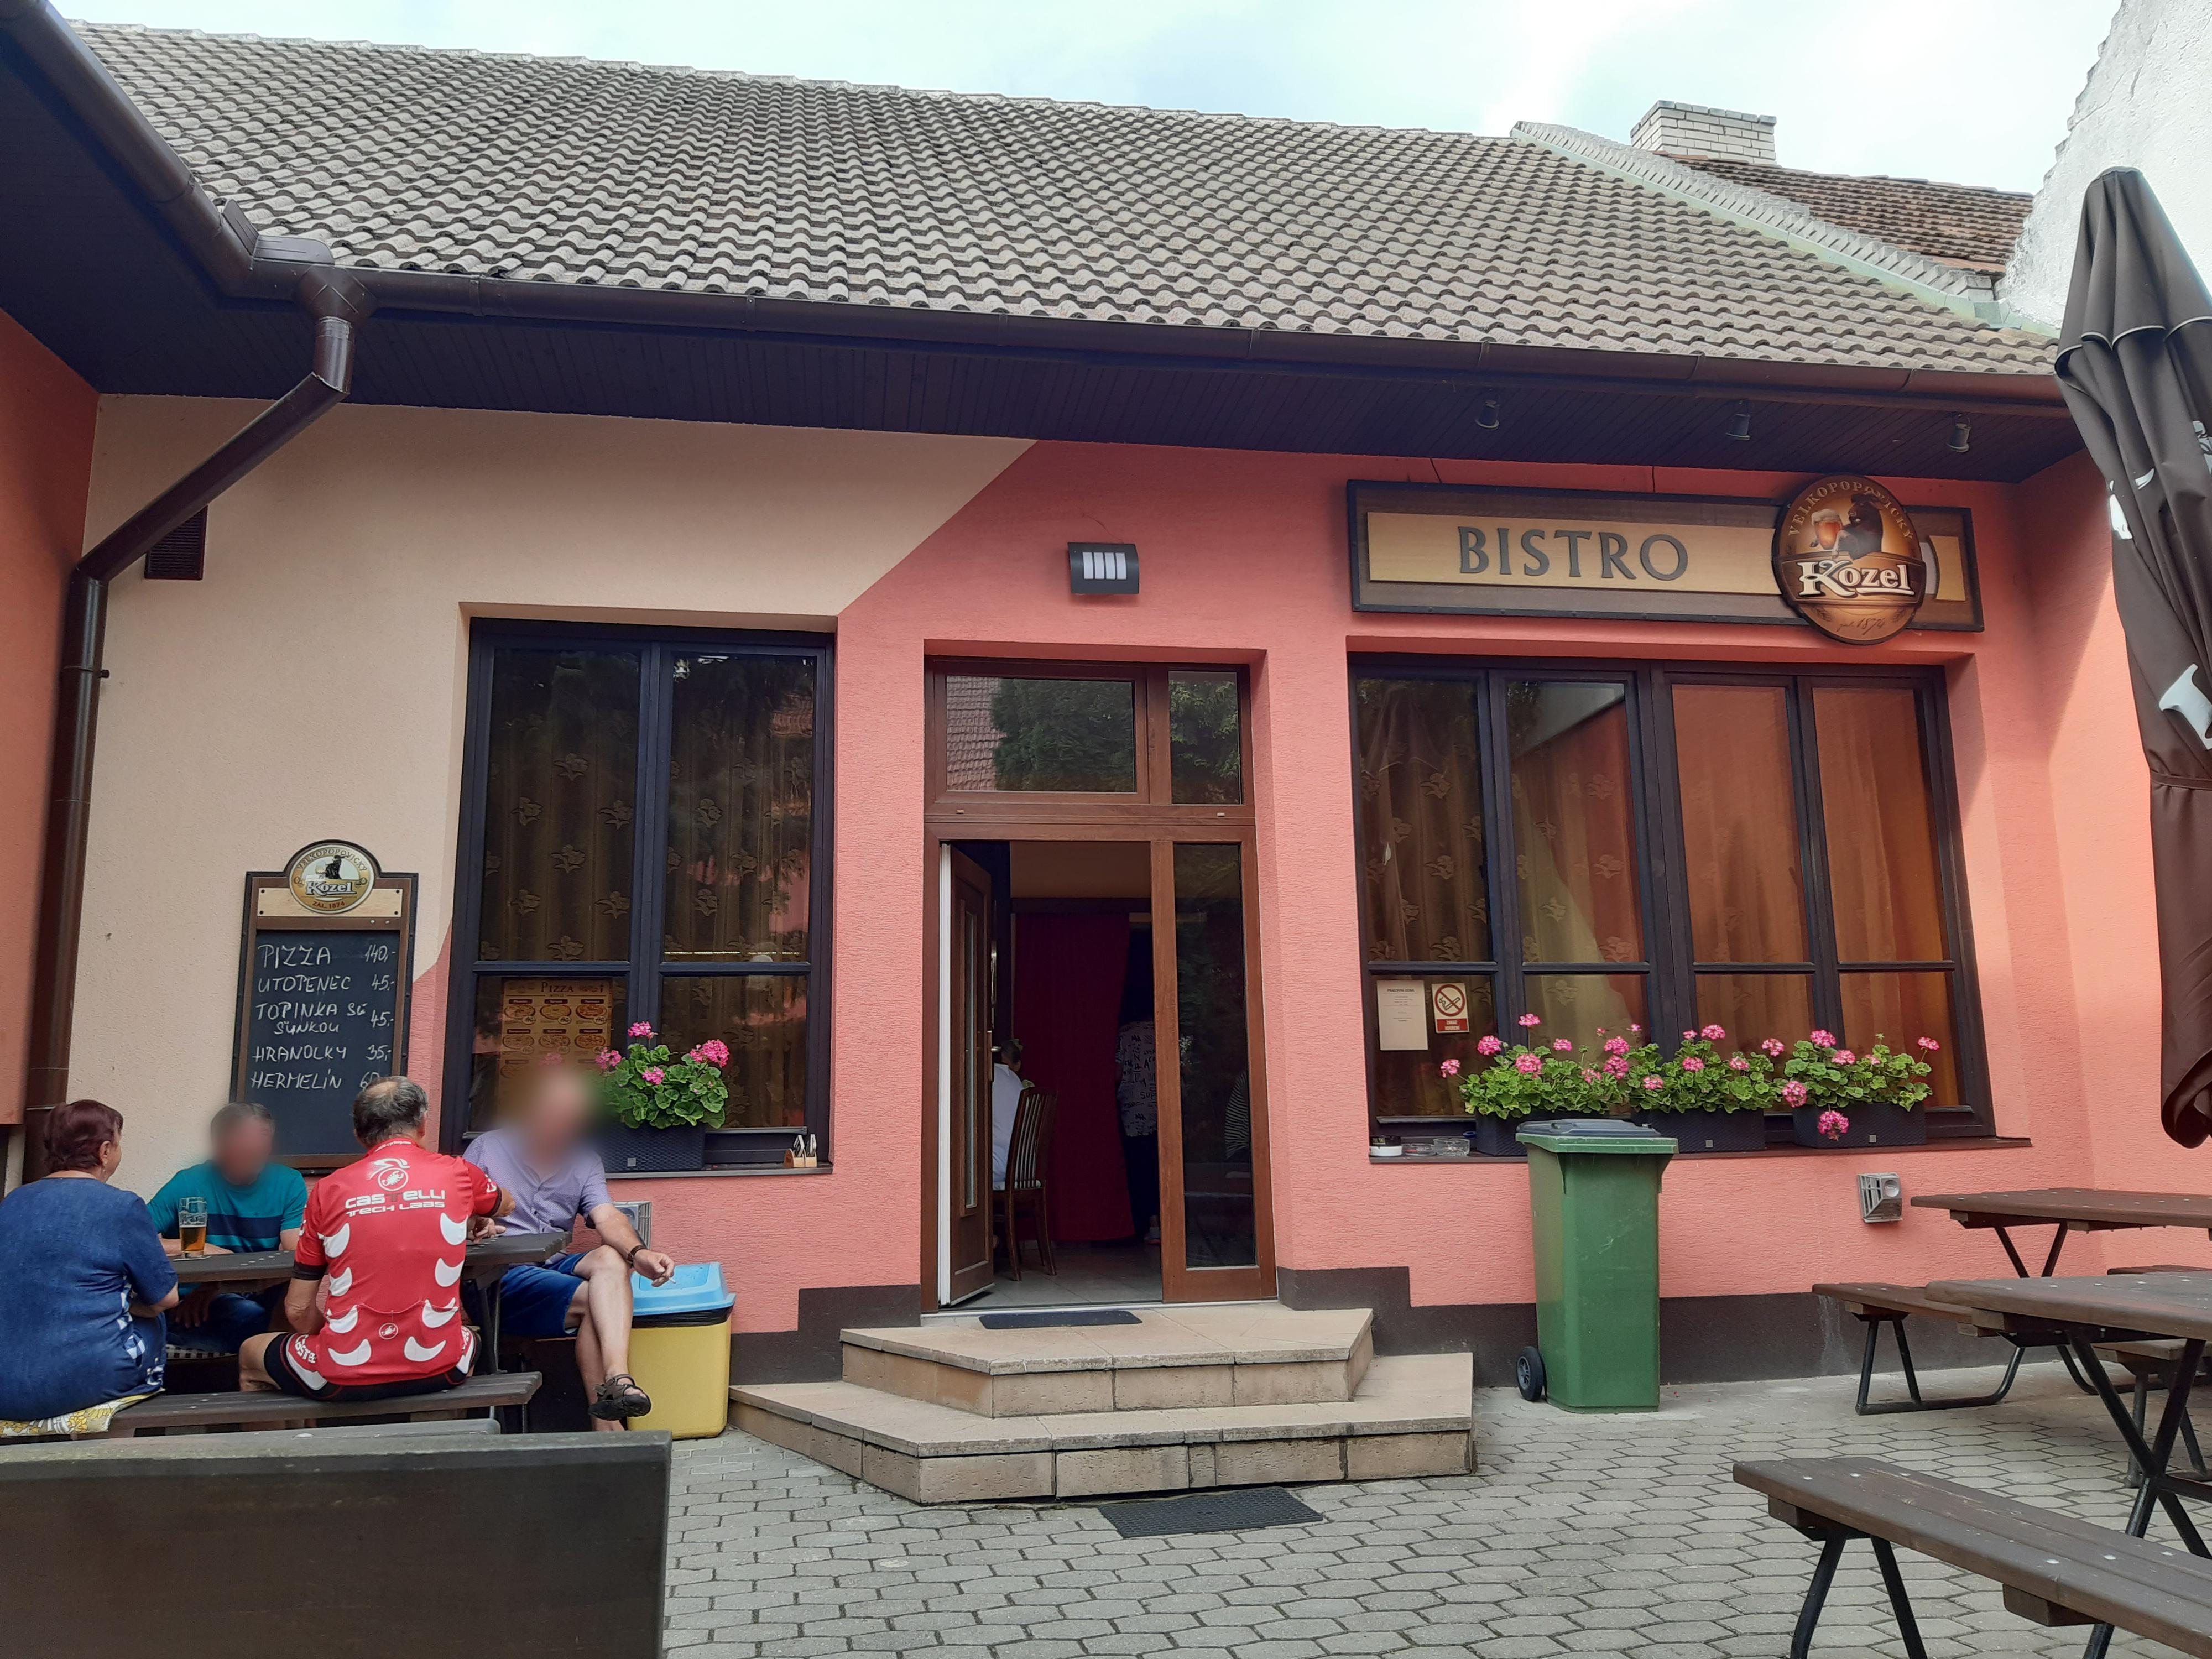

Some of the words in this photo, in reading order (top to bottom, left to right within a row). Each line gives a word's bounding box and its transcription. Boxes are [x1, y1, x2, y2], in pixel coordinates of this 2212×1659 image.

[1458, 526, 1688, 581] BISTRO
[1797, 560, 1915, 597] Kozel
[306, 881, 357, 896] Kozel
[257, 944, 331, 969] PIZZA
[258, 974, 351, 992] UTOPENEC
[255, 1001, 337, 1020] TOPINKA
[252, 1045, 347, 1062] HRANOLKY
